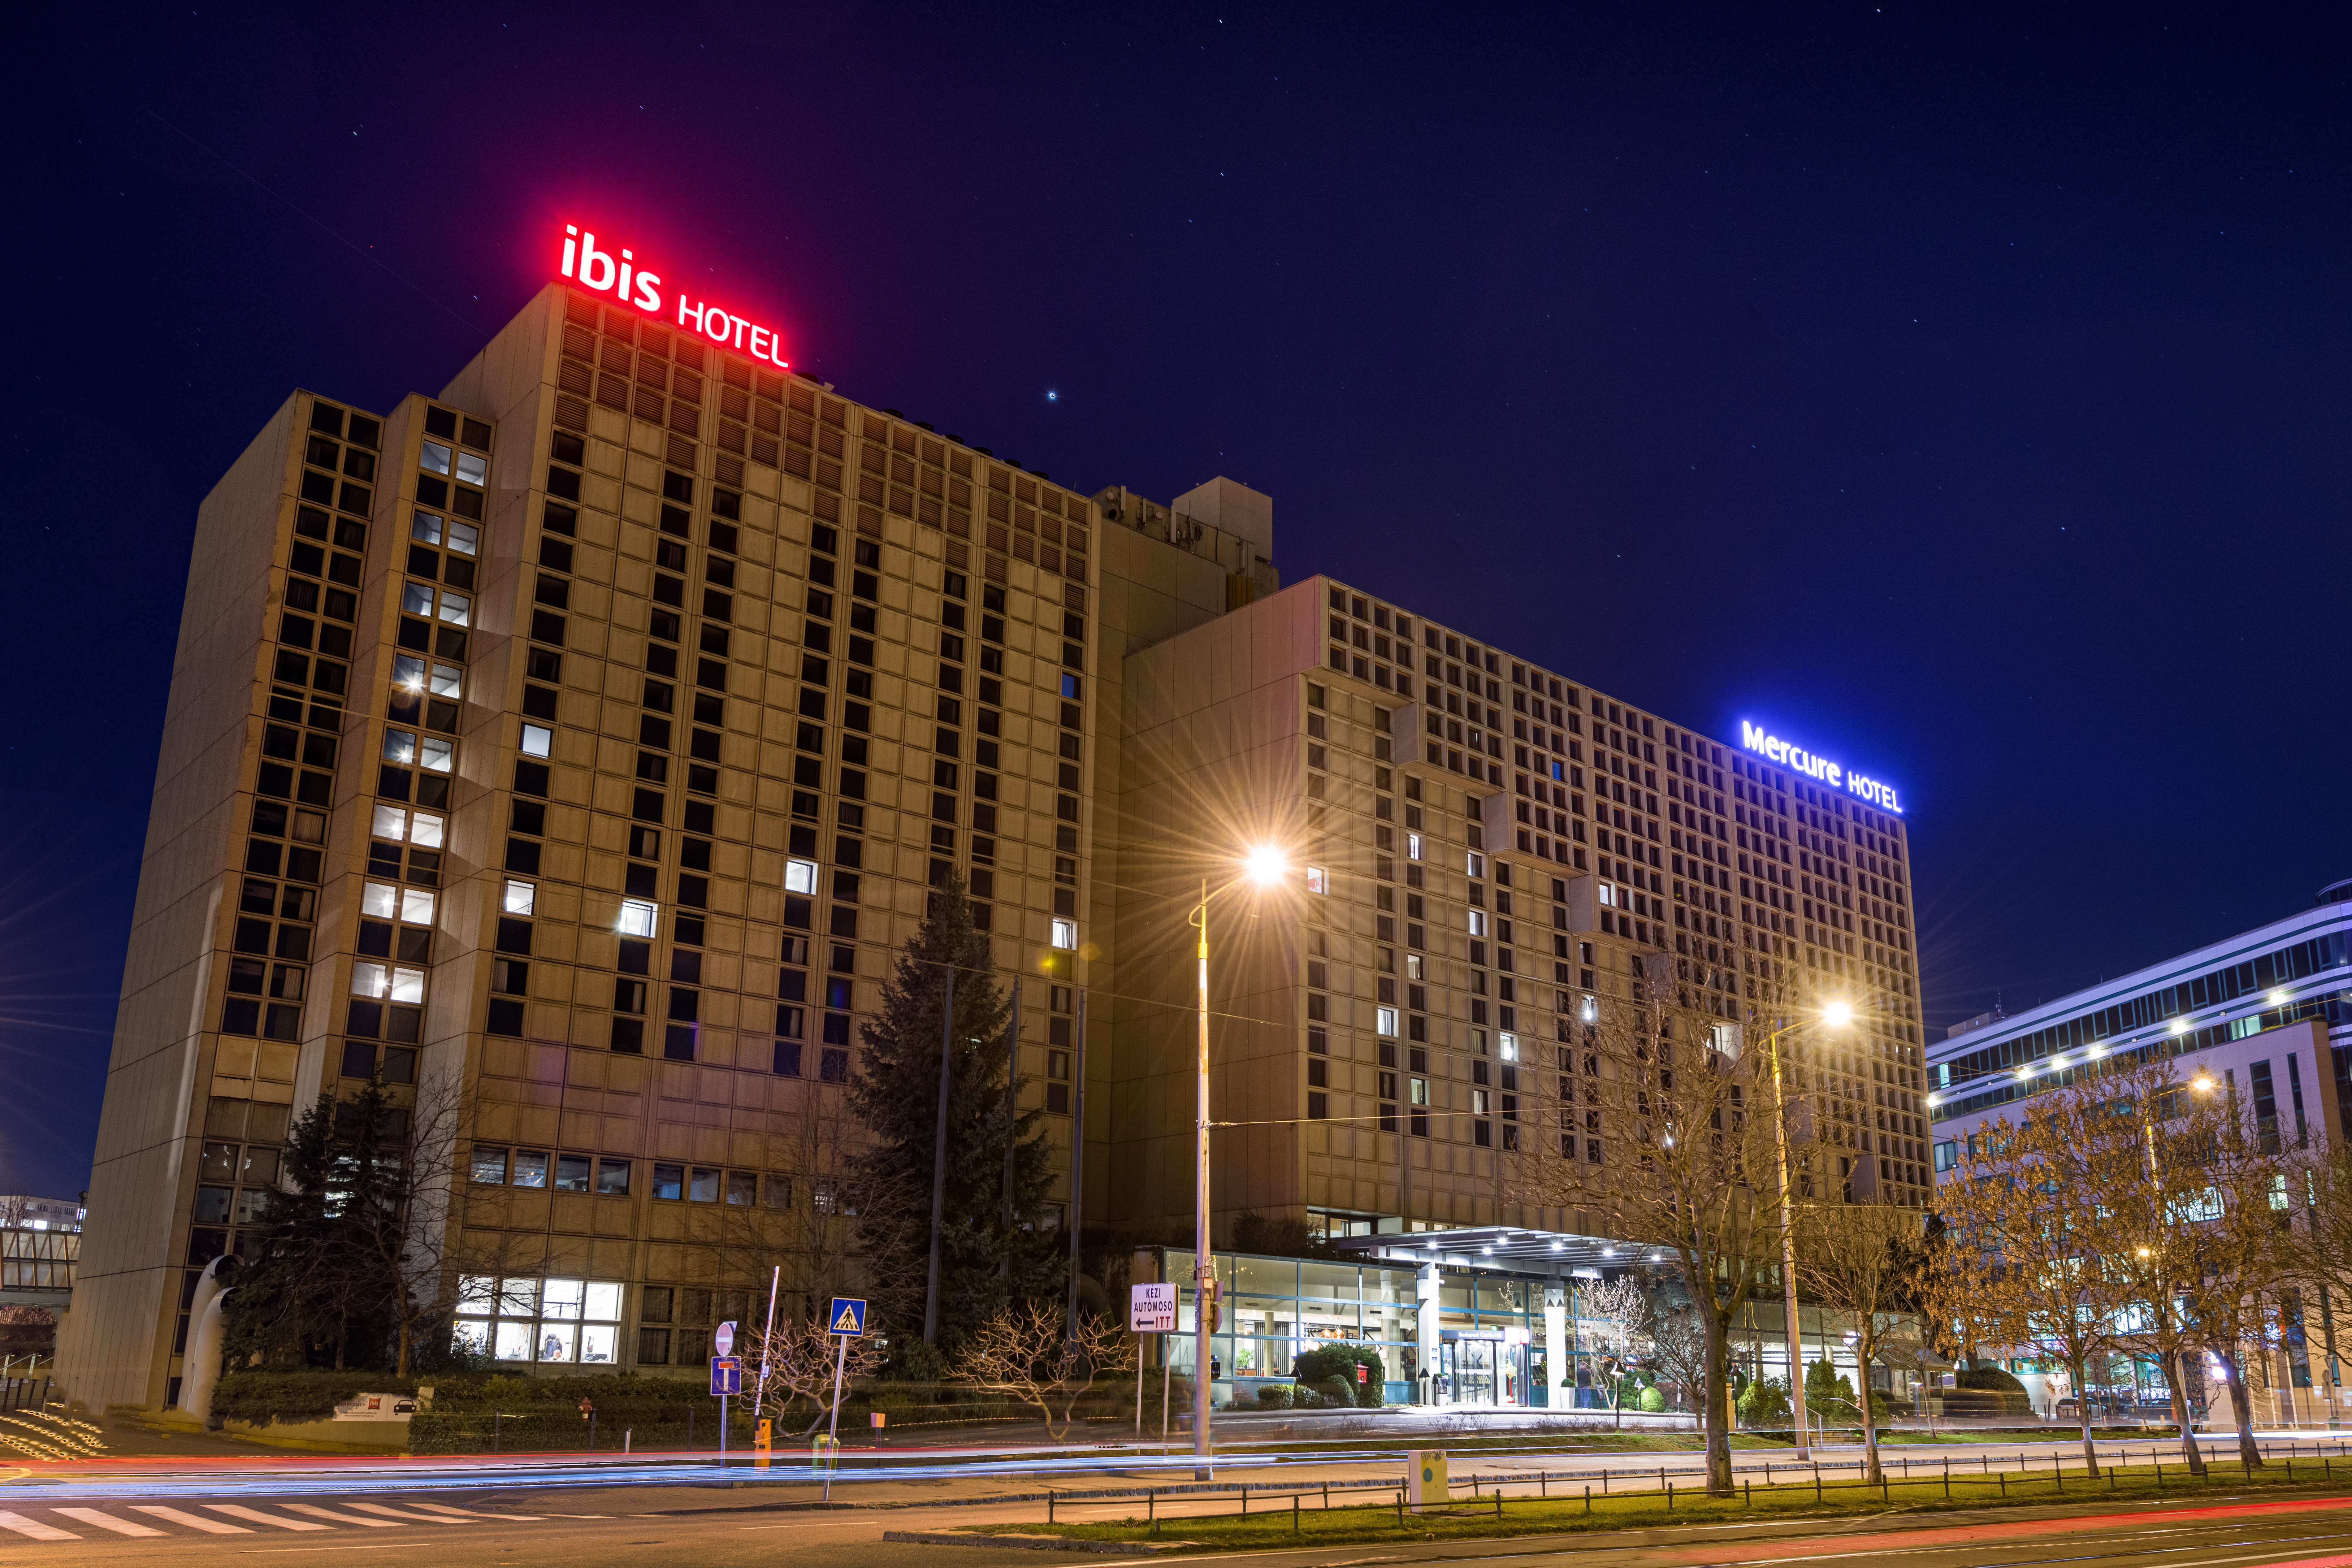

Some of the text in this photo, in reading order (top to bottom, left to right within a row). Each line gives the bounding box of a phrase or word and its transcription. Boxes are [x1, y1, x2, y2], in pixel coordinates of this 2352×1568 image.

[561, 224, 788, 368] ibis HOTEL
[1743, 721, 1902, 812] Mercure HOTEL
[1146, 1285, 1161, 1298] KÉZI
[1134, 1298, 1172, 1312] AUTÓMOSÓ
[1156, 1316, 1170, 1328] ITT
